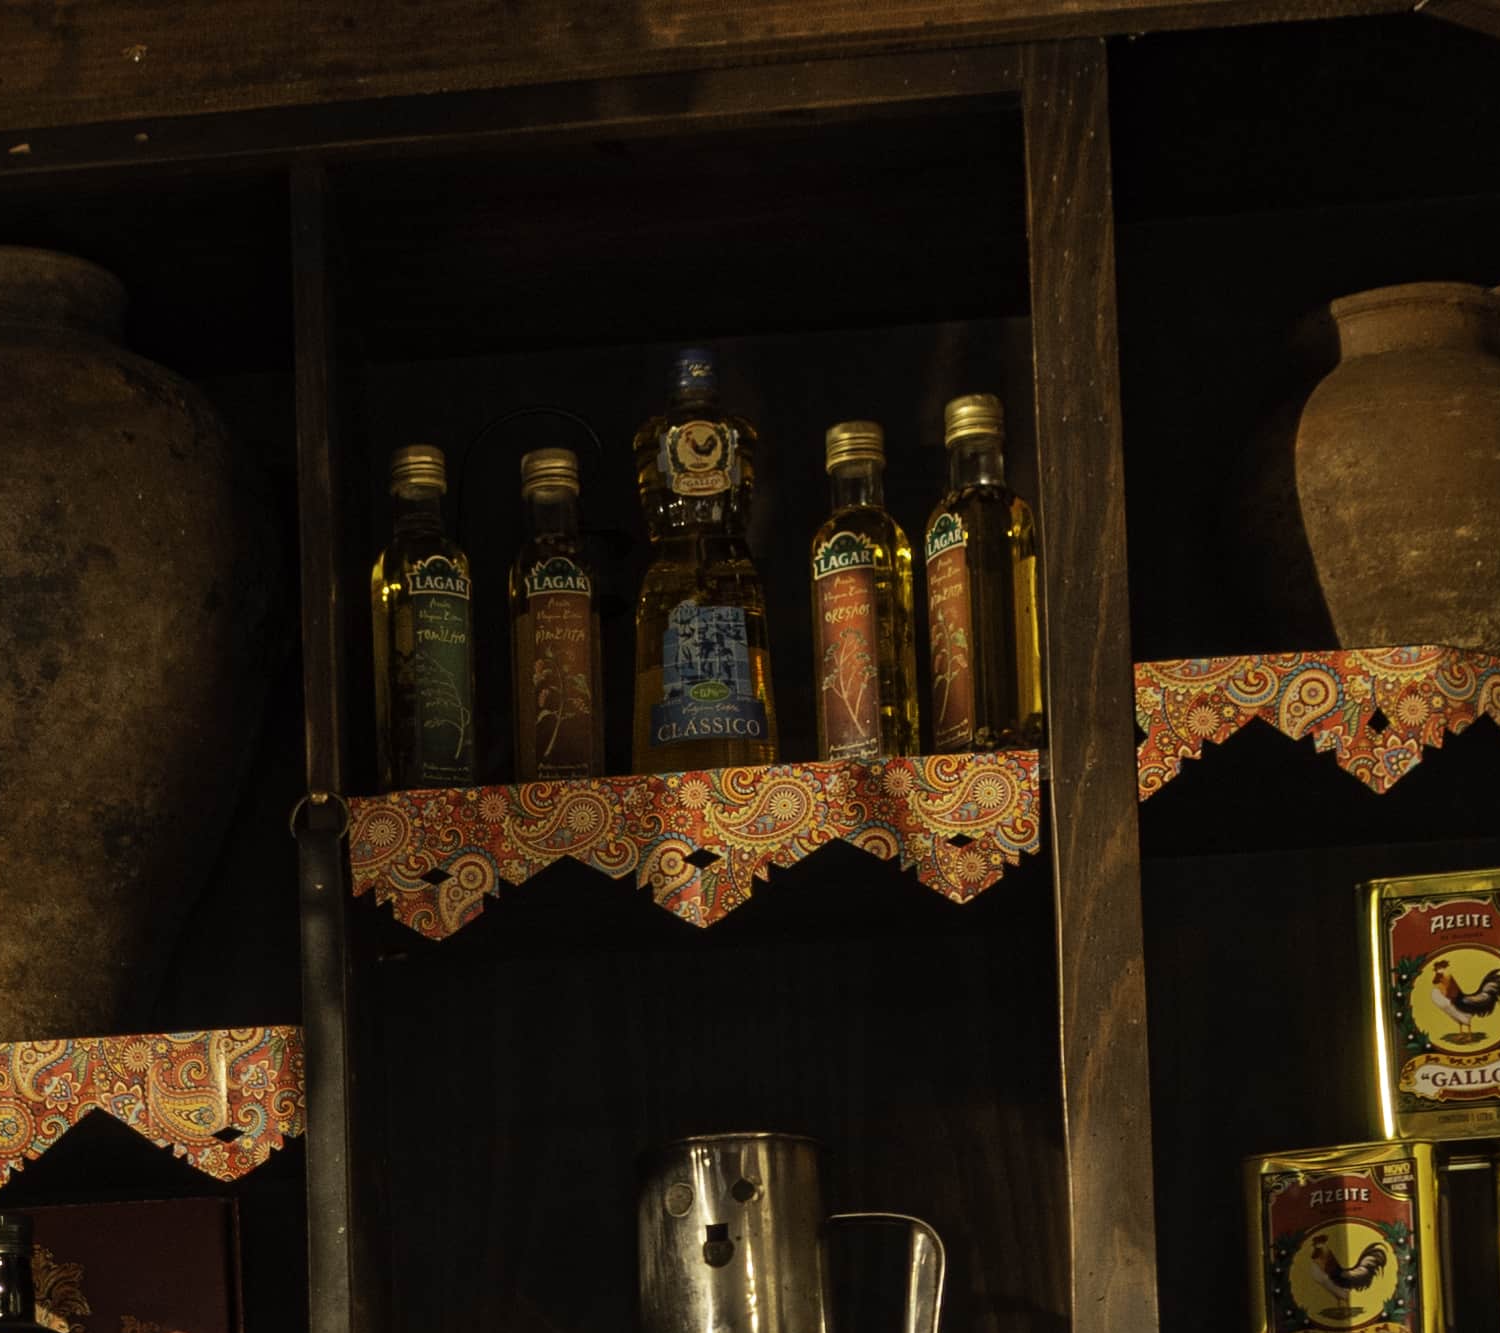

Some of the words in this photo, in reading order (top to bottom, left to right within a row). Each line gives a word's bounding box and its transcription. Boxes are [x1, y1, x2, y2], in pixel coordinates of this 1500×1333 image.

[927, 527, 964, 554] LAGAR
[819, 551, 872, 573] LAGAR
[415, 575, 466, 593] LAGAR
[532, 575, 587, 591] LAGAR
[1429, 913, 1493, 935] AZEITE
[1309, 1187, 1370, 1208] AZEITE
